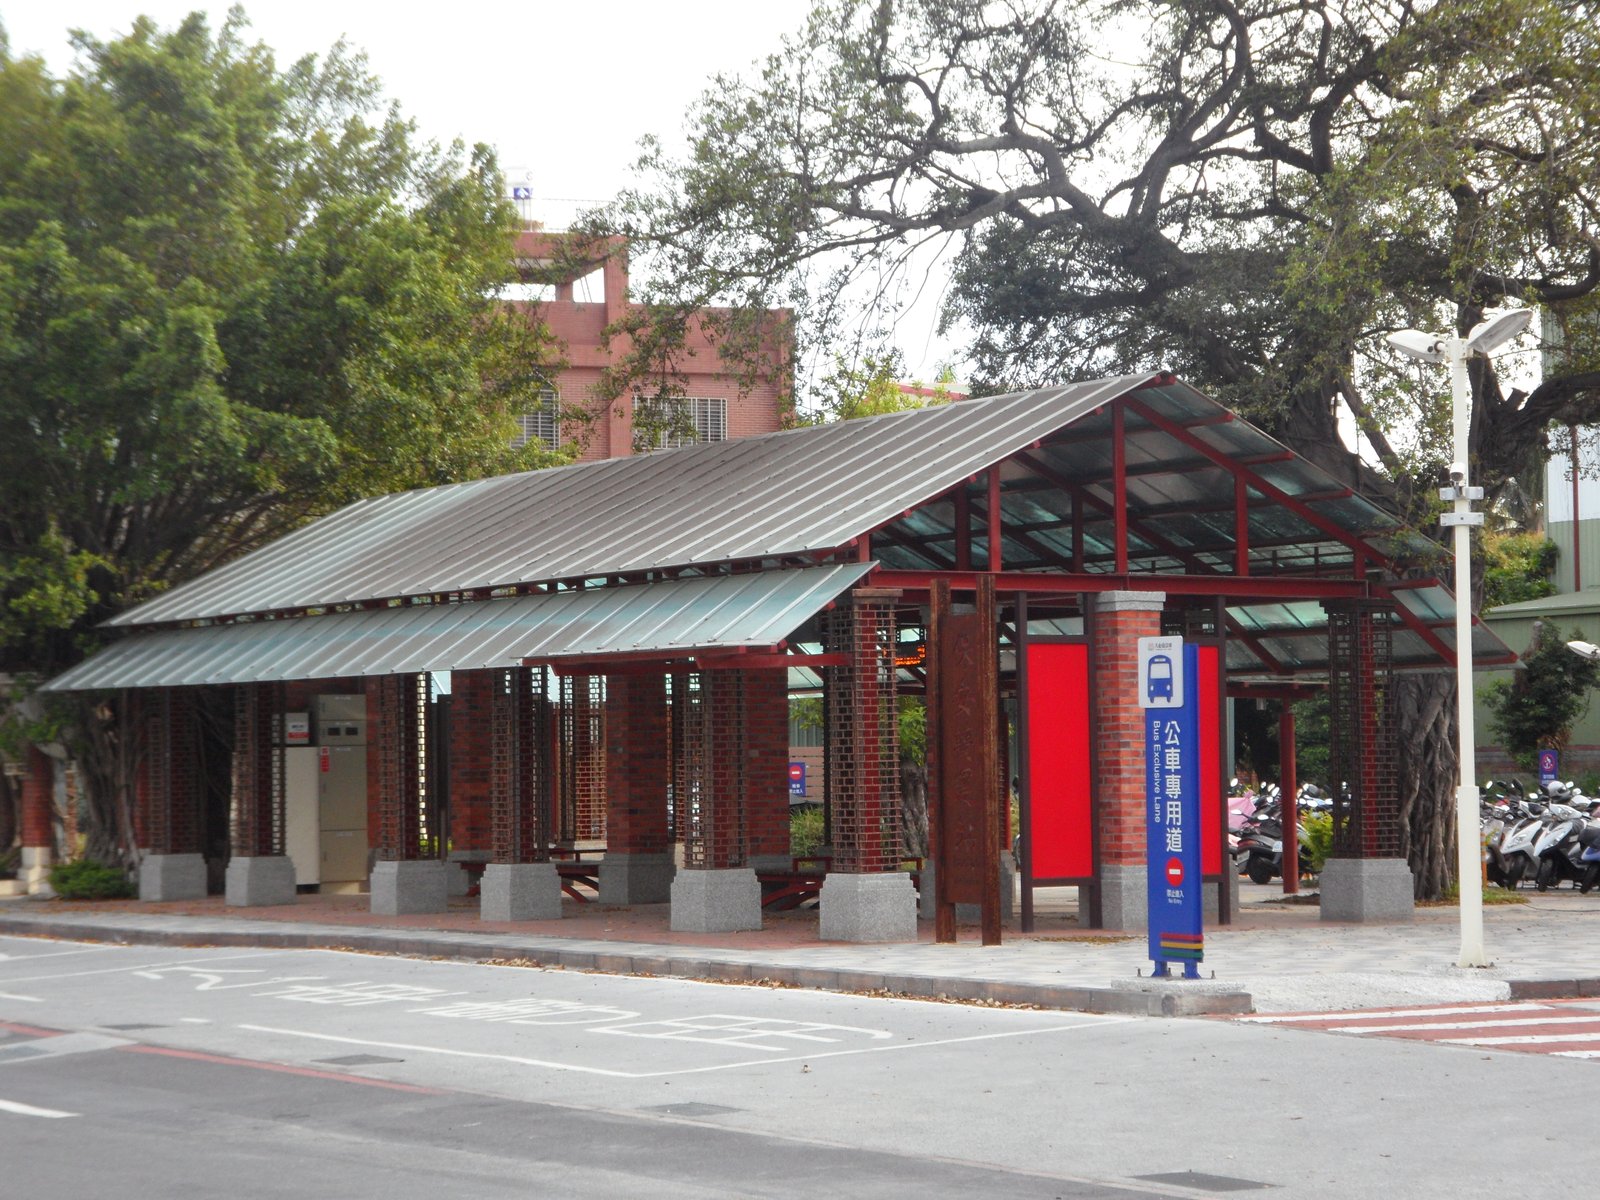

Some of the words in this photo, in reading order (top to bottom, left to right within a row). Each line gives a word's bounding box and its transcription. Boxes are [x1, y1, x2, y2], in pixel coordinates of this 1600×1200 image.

[1153, 720, 1161, 741] Bus
[1153, 744, 1162, 794] Exclusive
[1164, 720, 1182, 852] 公車專用道
[1154, 796, 1162, 823] Lane
